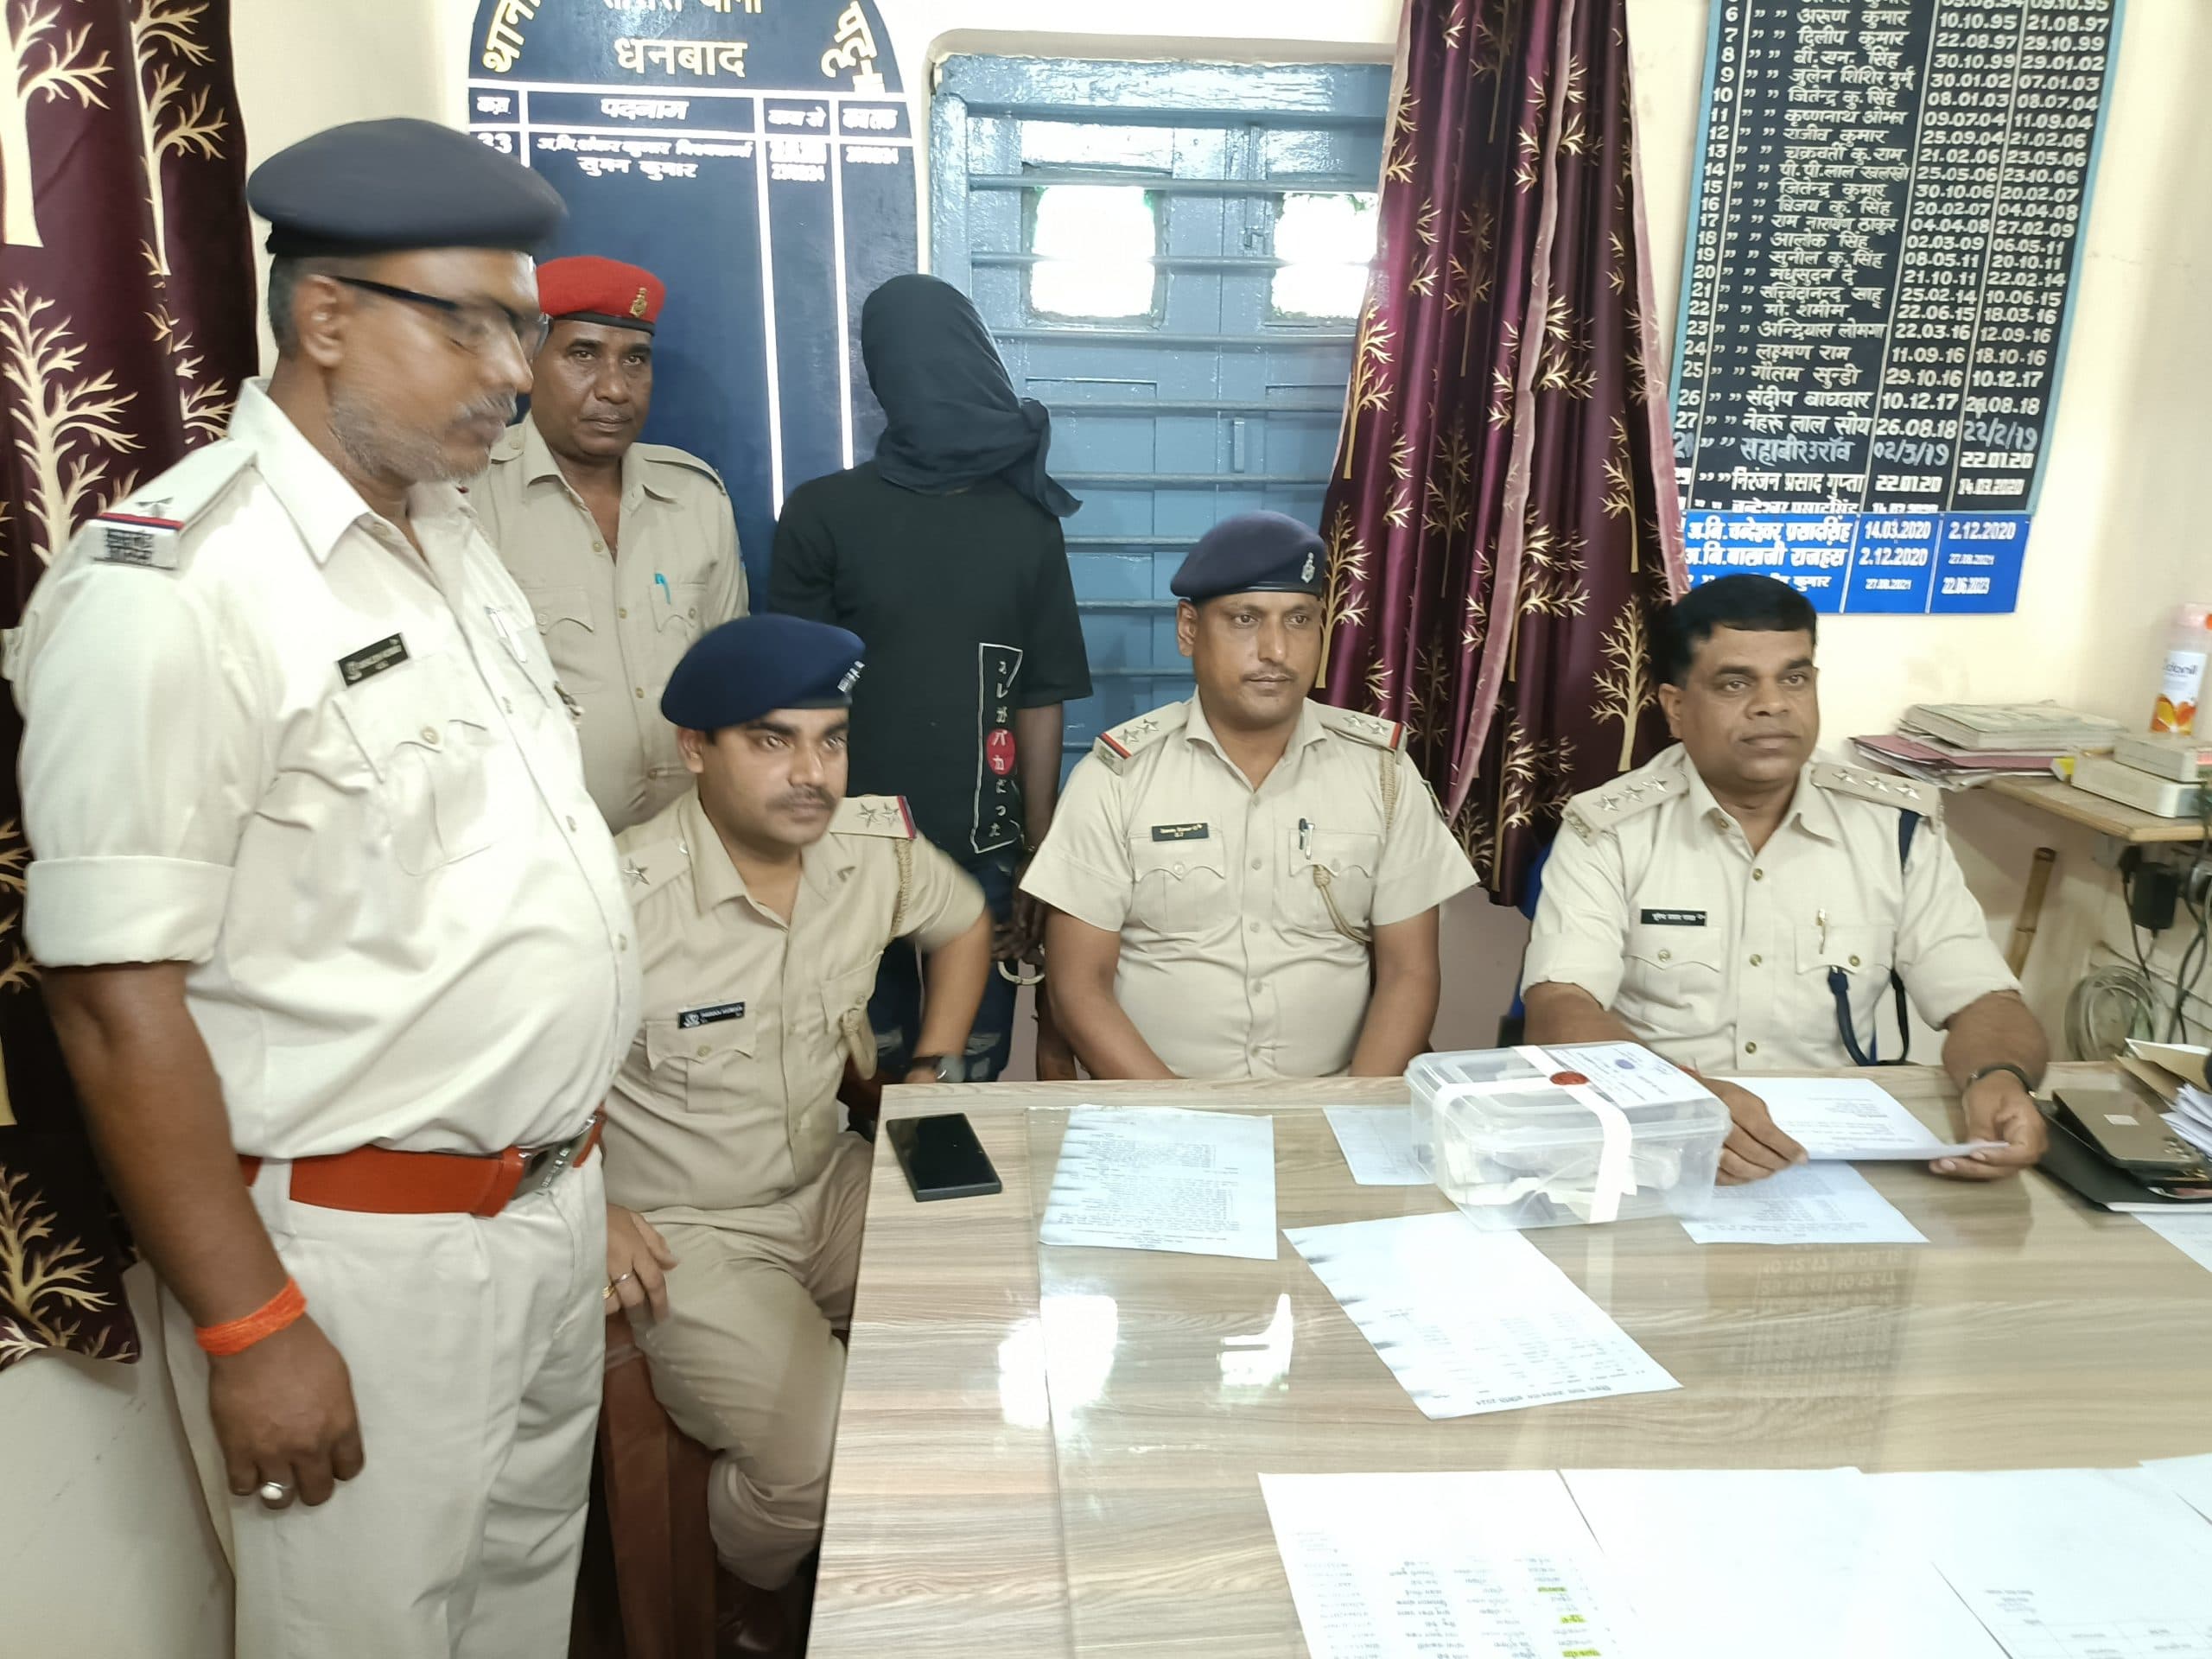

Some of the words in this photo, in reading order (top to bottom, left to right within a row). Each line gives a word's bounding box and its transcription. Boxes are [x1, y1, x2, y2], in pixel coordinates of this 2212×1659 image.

[1726, 7, 1738, 22] 6
[1861, 10, 1911, 29] कुमार
[1940, 12, 2018, 30] 10.10.95
[2027, 14, 2110, 33] 21.08.97
[1725, 28, 1738, 42] 7
[1797, 25, 1850, 47] दिलीप
[1858, 31, 1910, 49] कुमार
[1936, 33, 2018, 50] 22.08.97
[2023, 35, 2106, 53] 29.10.99
[614, 37, 748, 78] धनबाद
[1721, 47, 1735, 62] 8
[1866, 46, 1903, 68] सिंह
[1933, 54, 2017, 69] 30.10.99
[2021, 54, 2105, 72] 29.01.02
[1720, 67, 1735, 82] 9
[1840, 66, 1886, 84] शिशिर
[1930, 73, 2012, 89] 30.01.02
[2018, 74, 2101, 92] 07.01.03
[1713, 87, 1733, 102] 10
[1842, 91, 1863, 109] कु.
[1866, 86, 1897, 107] सिंह
[1927, 92, 2010, 108] 08.01.03
[2017, 93, 2100, 111] 08.07.04
[1711, 108, 1728, 122] 11
[1923, 111, 2007, 127] 09.07.04
[2014, 113, 2094, 130] 11.09.04
[1709, 125, 1729, 139] 12
[1783, 124, 1833, 142] राजीव
[1840, 130, 1889, 148] कुमार
[1921, 130, 2004, 146] 25.09.04
[2009, 132, 2088, 149] 21.02.06
[1707, 143, 1727, 158] 13
[1851, 148, 1872, 166] कु.
[1873, 149, 1907, 162] राम
[1704, 162, 1726, 176] 14
[1916, 166, 1999, 182] 25.05.06
[1703, 180, 1722, 194] 15
[1841, 183, 1888, 200] कुमार
[2001, 187, 2080, 203] 20.02.07
[1701, 197, 1719, 211] 16
[1775, 194, 1822, 213] विजय
[1829, 200, 1851, 218] कु.
[1858, 198, 1894, 216] सिंह
[1997, 203, 2079, 221] 04.04.08
[1700, 213, 1719, 227] 17
[1770, 214, 1801, 228] राम
[1858, 217, 1898, 236] ठाकुर
[1699, 231, 1717, 245] 18
[1770, 227, 1830, 248] आलोक
[1837, 231, 1870, 250] सिंह
[1696, 247, 1716, 261] 19
[1769, 247, 1824, 268] सुनील
[1827, 251, 1848, 269] कु.
[1851, 250, 1887, 269] सिंह
[1693, 264, 1715, 278] 20
[1692, 282, 1712, 298] 21
[1851, 287, 1886, 309] साहू
[1689, 301, 1710, 315] 22
[1764, 301, 1790, 316] मो.
[1796, 300, 1851, 318] शमीम
[1687, 320, 1709, 335] 23
[1685, 340, 1707, 356] 24
[1819, 345, 1852, 360] राम
[1682, 361, 1704, 378] 25
[1751, 361, 1805, 382] गौतम
[1972, 370, 2044, 388] 10.12.17
[1678, 389, 1700, 406] 26
[1745, 385, 1799, 412] संदीप
[1881, 391, 1960, 410] 10.12.17
[1675, 411, 1699, 429] 27
[1790, 415, 1831, 434] लाल
[1834, 411, 1873, 435] सोय
[1875, 418, 1958, 440] 26.08.18
[1962, 417, 2038, 452] 22/2/19
[1873, 439, 1950, 467] 02/3/19
[1731, 466, 1782, 491] निरंजन
[1784, 474, 1825, 493] प्रसाद
[1827, 474, 1866, 499] गुप्ता
[1865, 521, 1931, 540] 14.03.2020
[1948, 521, 2017, 540] 2.12.2020
[1859, 547, 1929, 566] 2.12.2020
